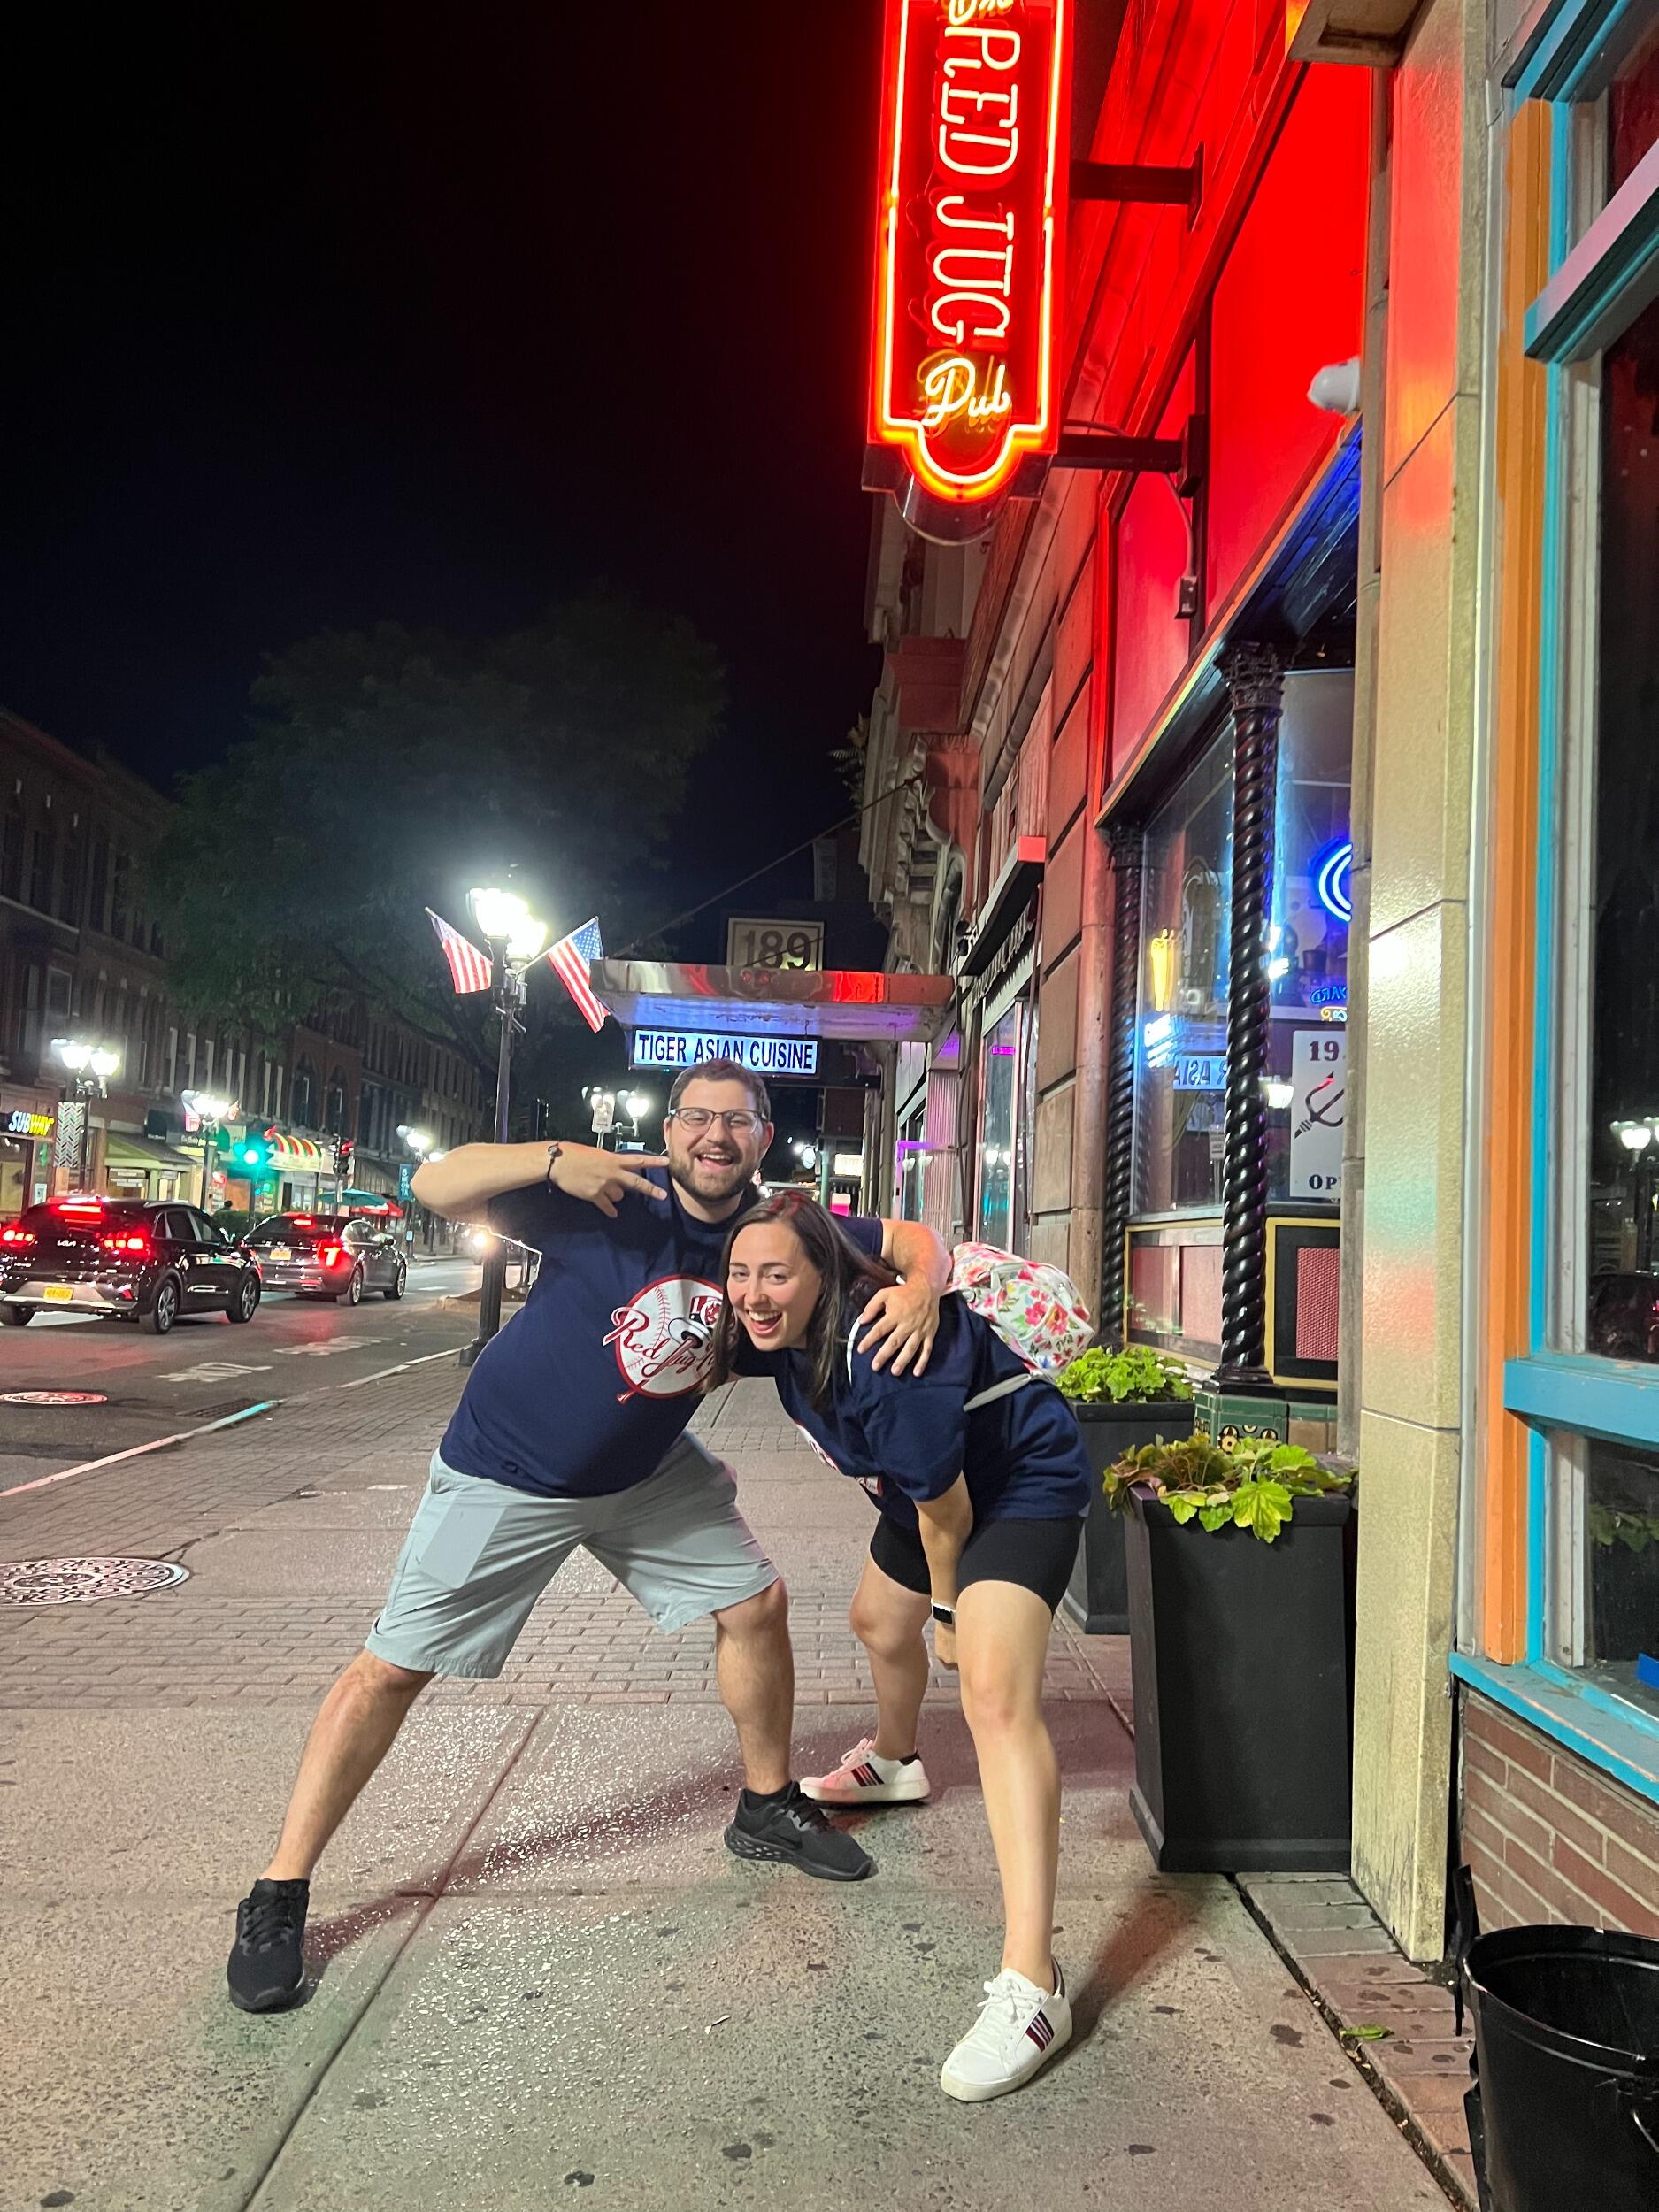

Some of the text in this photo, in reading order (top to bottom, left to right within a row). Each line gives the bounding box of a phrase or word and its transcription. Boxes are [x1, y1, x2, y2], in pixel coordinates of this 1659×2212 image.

[939, 26, 1021, 175] RED
[930, 194, 1014, 345] JUG
[923, 357, 1010, 427] Pub
[741, 930, 811, 970] 189
[638, 1033, 813, 1070] TIGER ASIAN CUISINE
[1309, 1041, 1346, 1062] 19
[8, 1110, 55, 1136] SUBWAY
[1308, 1173, 1342, 1190] OP
[603, 1306, 671, 1360] Red
